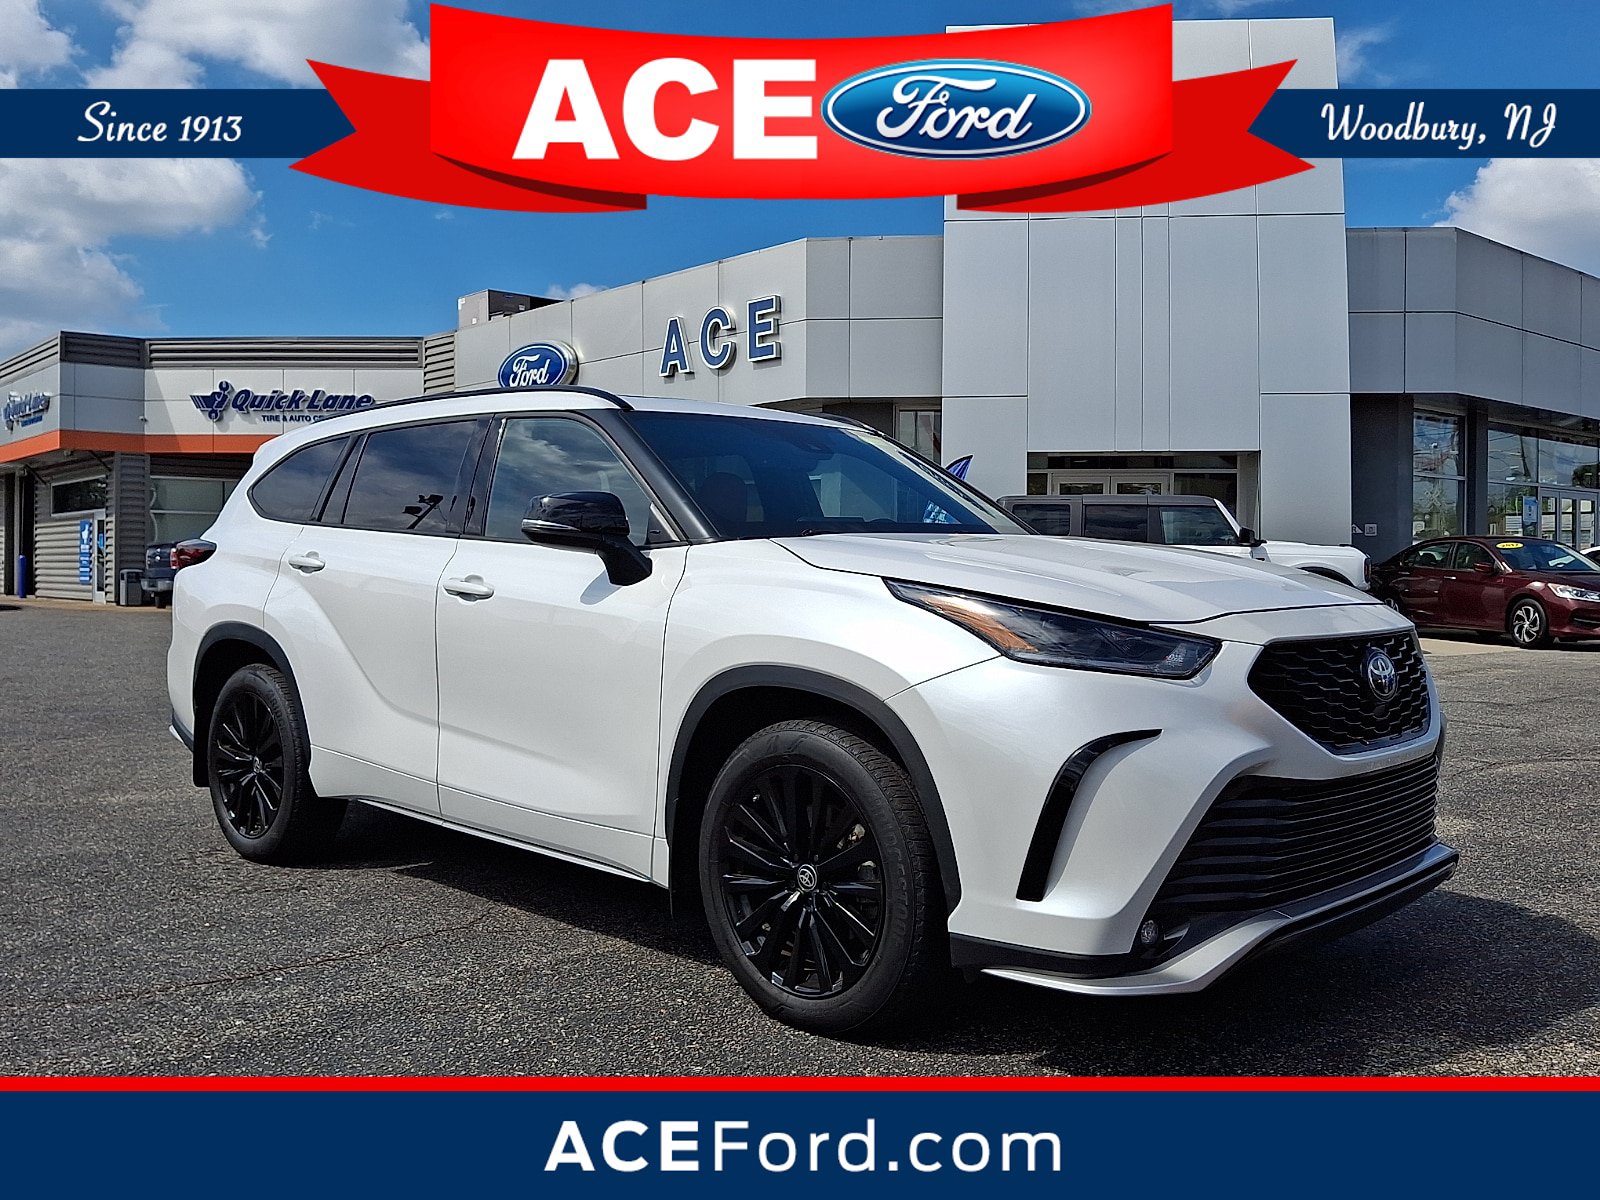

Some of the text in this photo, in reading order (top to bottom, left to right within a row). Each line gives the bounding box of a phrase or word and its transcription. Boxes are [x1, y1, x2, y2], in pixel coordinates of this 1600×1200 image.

[659, 295, 782, 377] ACE
[509, 353, 549, 386] Ford
[231, 389, 375, 412] Quick Lane
[261, 414, 280, 422] TIRE
[289, 414, 311, 422] AUTO
